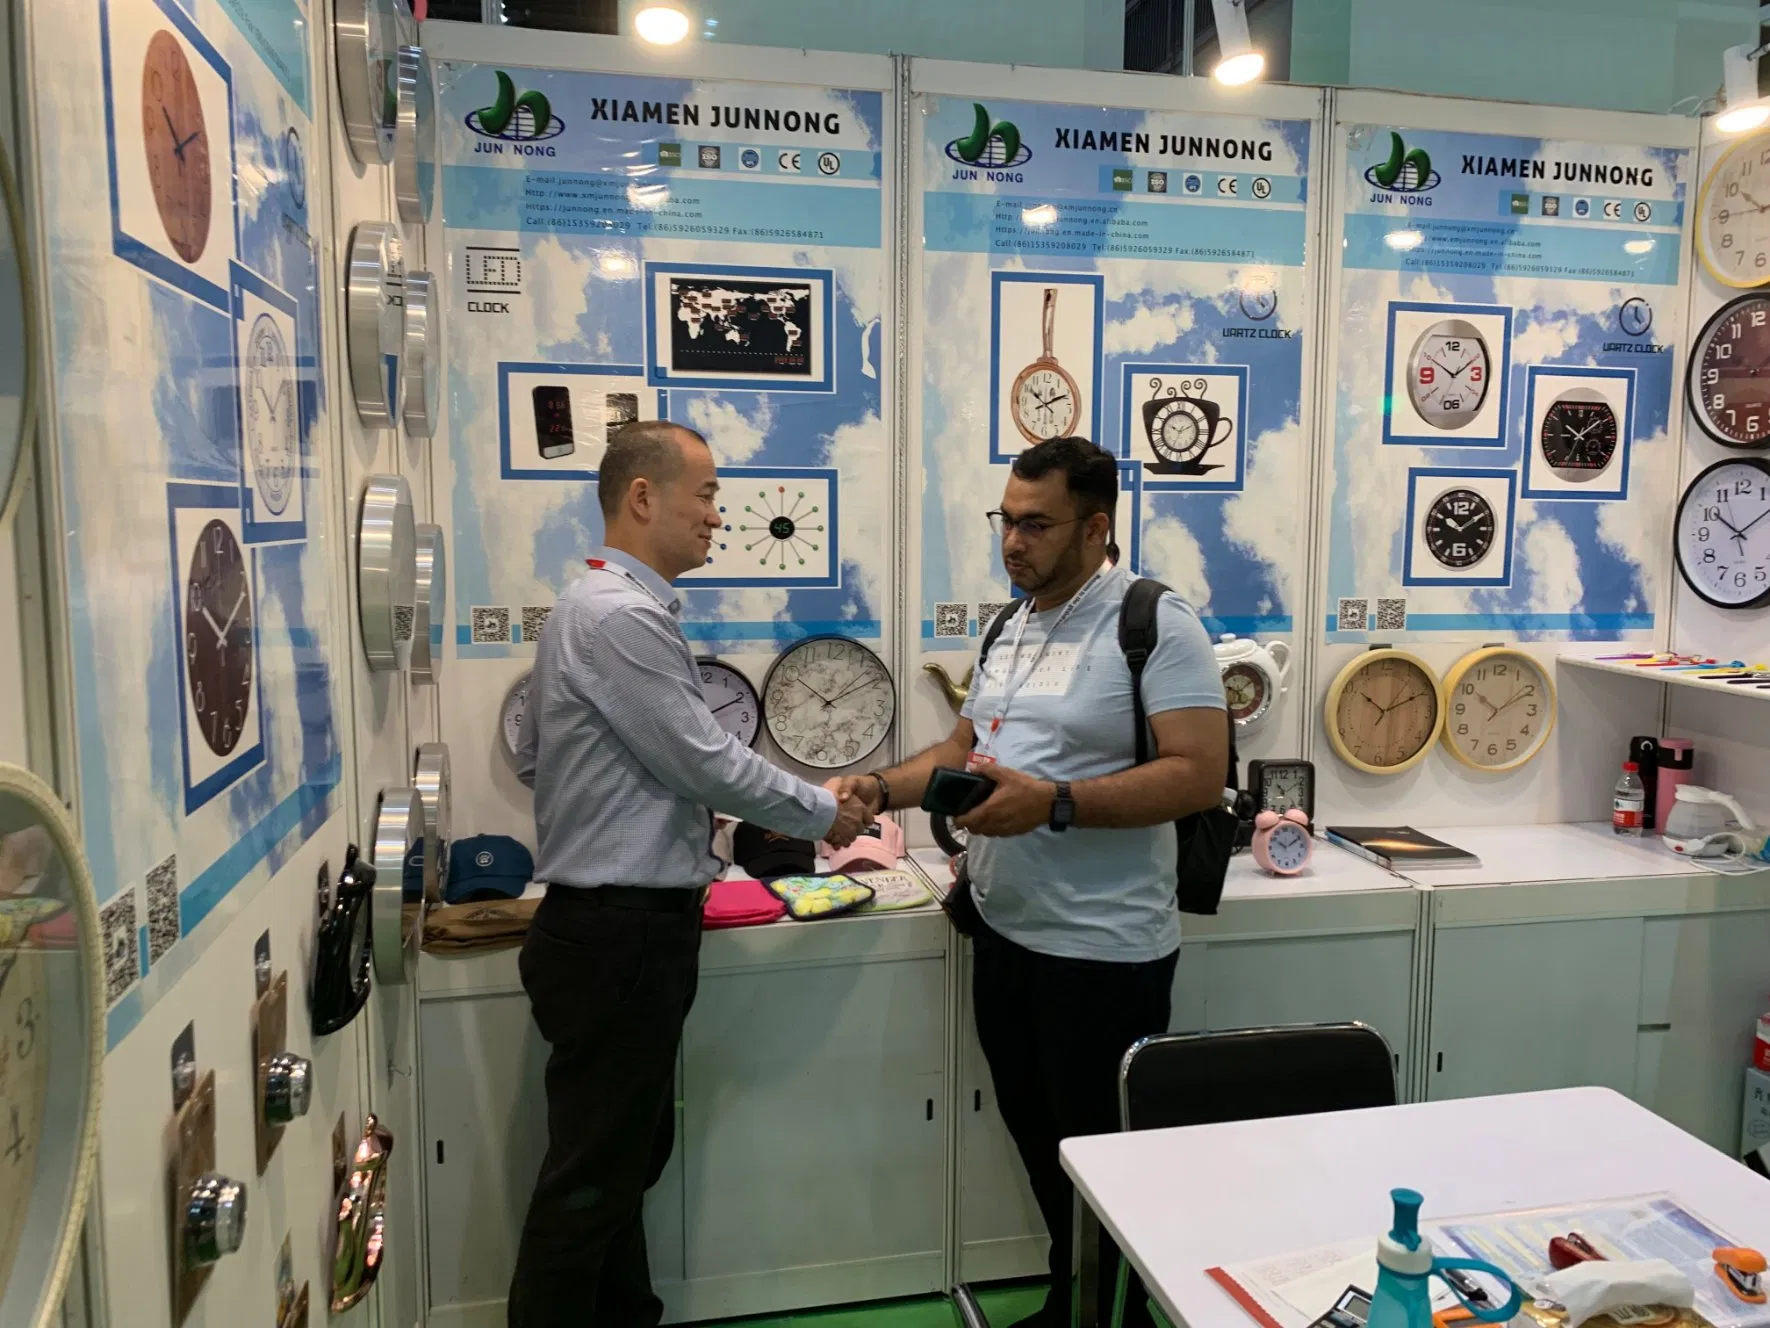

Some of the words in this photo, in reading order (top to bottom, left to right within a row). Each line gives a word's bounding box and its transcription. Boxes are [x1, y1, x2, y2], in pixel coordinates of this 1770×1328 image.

[590, 98, 699, 126] XIAMEN
[710, 105, 840, 135] JUNNONG
[474, 142, 503, 154] JUN
[514, 144, 556, 157] NONG
[1055, 127, 1150, 153] XIAMEN
[1158, 134, 1272, 162] JUNNONG
[1461, 155, 1545, 179] XIAMEN
[1553, 161, 1653, 187] JUNNONG
[1742, 160, 1752, 176] 11
[952, 169, 978, 180] JUN
[987, 171, 1024, 183] NONG
[1725, 182, 1739, 198] 10
[1370, 193, 1393, 204] JUN
[1400, 195, 1433, 206] NONG
[1719, 209, 1730, 224] 9
[1721, 233, 1733, 248] 8
[1735, 250, 1745, 266] 7
[1754, 252, 1766, 268] 6
[465, 255, 521, 285] LED
[467, 301, 510, 313] CLOCK
[1750, 311, 1766, 327] 12
[1258, 328, 1292, 339] CLOCK
[1731, 323, 1741, 339] 11
[1445, 341, 1460, 351] 12
[1715, 344, 1732, 360] 10
[1419, 367, 1434, 385] 9
[1470, 366, 1482, 382] 3
[1707, 368, 1719, 385] 9
[1443, 399, 1460, 410] 06
[1713, 394, 1725, 409] 8
[1725, 410, 1736, 426] 7
[1746, 416, 1760, 432] 6
[1734, 479, 1752, 495] 12
[1760, 487, 1766, 501] 1
[1716, 489, 1729, 503] 11
[1453, 501, 1470, 515] 12
[1703, 506, 1720, 522] 10
[774, 522, 790, 534] 45
[1698, 527, 1710, 542] 9
[1452, 543, 1467, 557] 6
[1703, 548, 1716, 564] 8
[1717, 565, 1729, 581] 7
[1734, 572, 1747, 588] 6
[1754, 566, 1767, 582] 5
[828, 642, 845, 661] 12
[1477, 669, 1486, 681] 11
[1493, 664, 1507, 676] 12
[1516, 669, 1520, 681] 1
[723, 677, 728, 688] 1
[1461, 683, 1474, 695] 10
[736, 691, 744, 704] 2
[1524, 685, 1535, 697] 2
[873, 699, 886, 717] 3
[1455, 703, 1466, 716] 9
[1526, 704, 1538, 717] 3
[741, 711, 750, 723] 3
[775, 715, 788, 732] 8
[862, 723, 875, 740] 4
[1457, 724, 1469, 735] 8
[1520, 724, 1530, 736] 4
[1470, 739, 1479, 751] 7
[1487, 744, 1498, 756] 6
[1505, 739, 1517, 751] 5
[1280, 769, 1288, 780] 12
